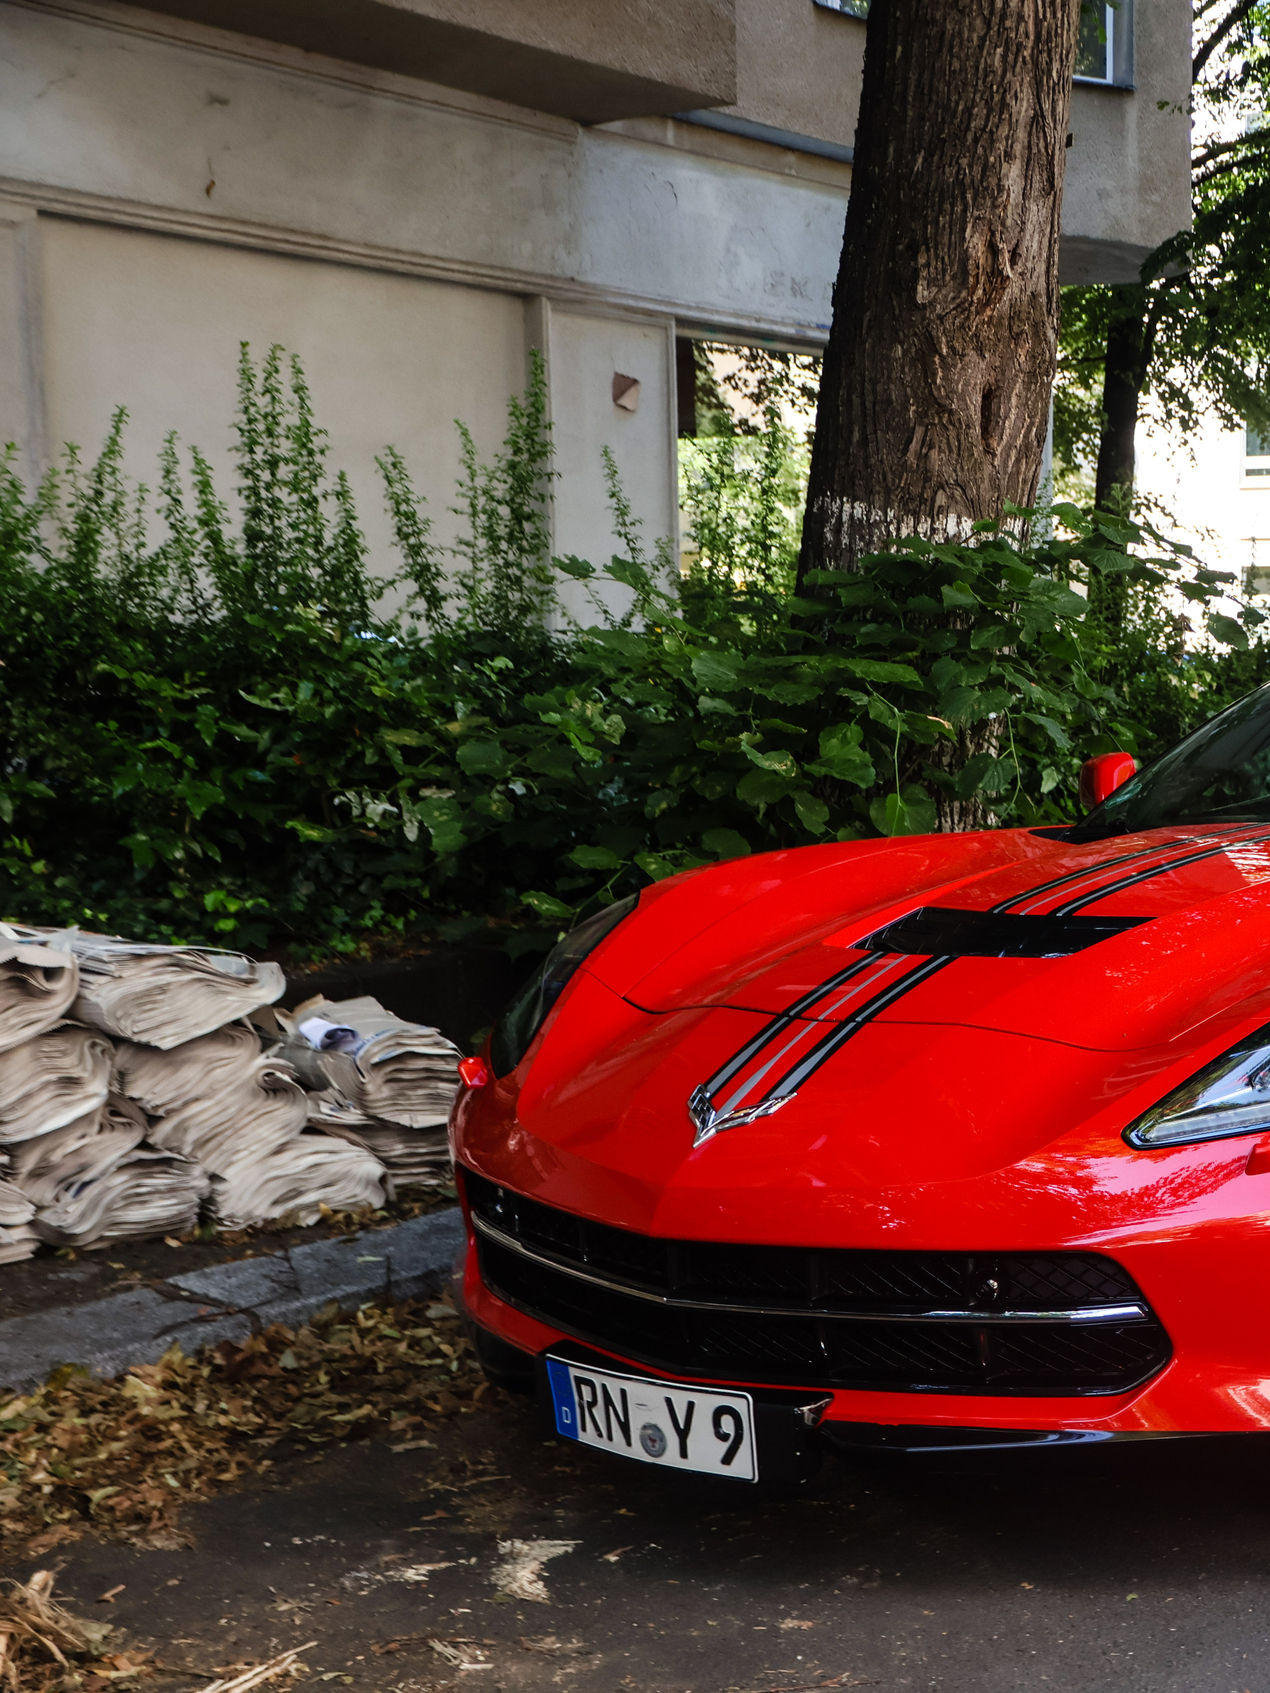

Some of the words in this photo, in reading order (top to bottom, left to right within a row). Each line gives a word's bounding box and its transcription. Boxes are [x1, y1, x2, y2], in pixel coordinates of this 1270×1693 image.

[561, 1406, 572, 1424] D
[573, 1374, 632, 1447] RN
[664, 1396, 696, 1459] Y
[712, 1404, 744, 1466] 9
